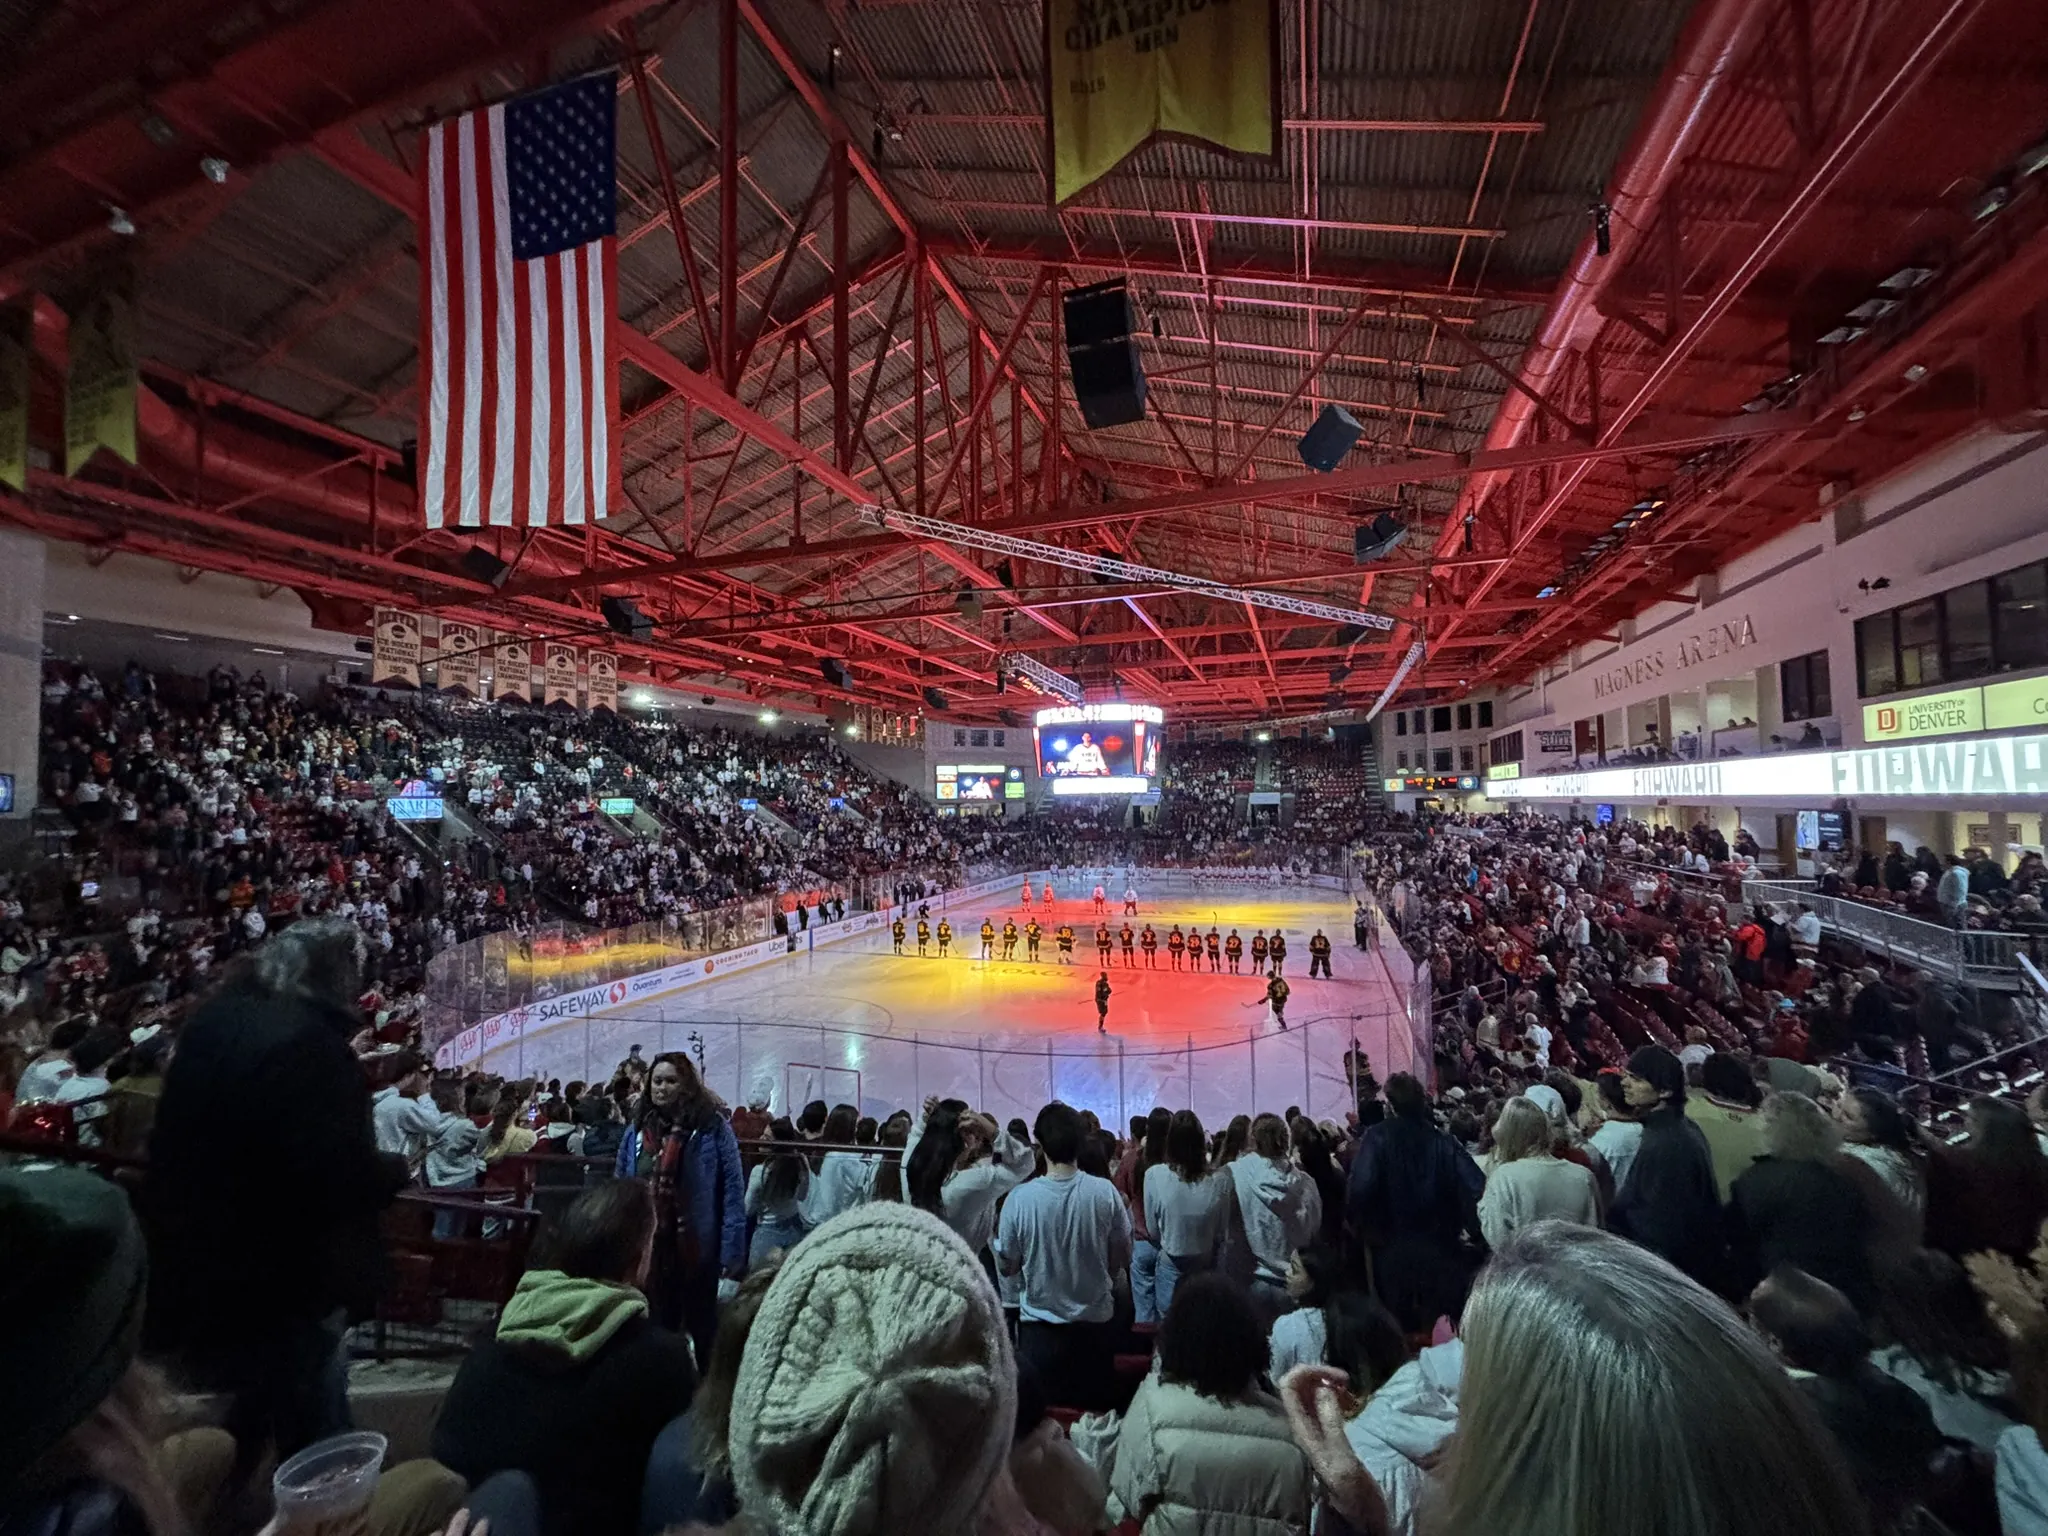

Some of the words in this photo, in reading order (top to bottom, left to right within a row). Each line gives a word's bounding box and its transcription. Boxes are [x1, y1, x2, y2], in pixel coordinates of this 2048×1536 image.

[1594, 652, 1664, 699] MAGNESS
[1676, 614, 1757, 670] ARENA
[1909, 700, 1957, 715] UNIVERSITY
[1909, 710, 1967, 731] DENVER
[1633, 763, 1722, 795] FORWARD
[768, 941, 786, 953] Uber
[1171, 935, 1180, 944] 10
[632, 977, 662, 991] Quantum
[539, 988, 609, 1022] SAFEWAY
